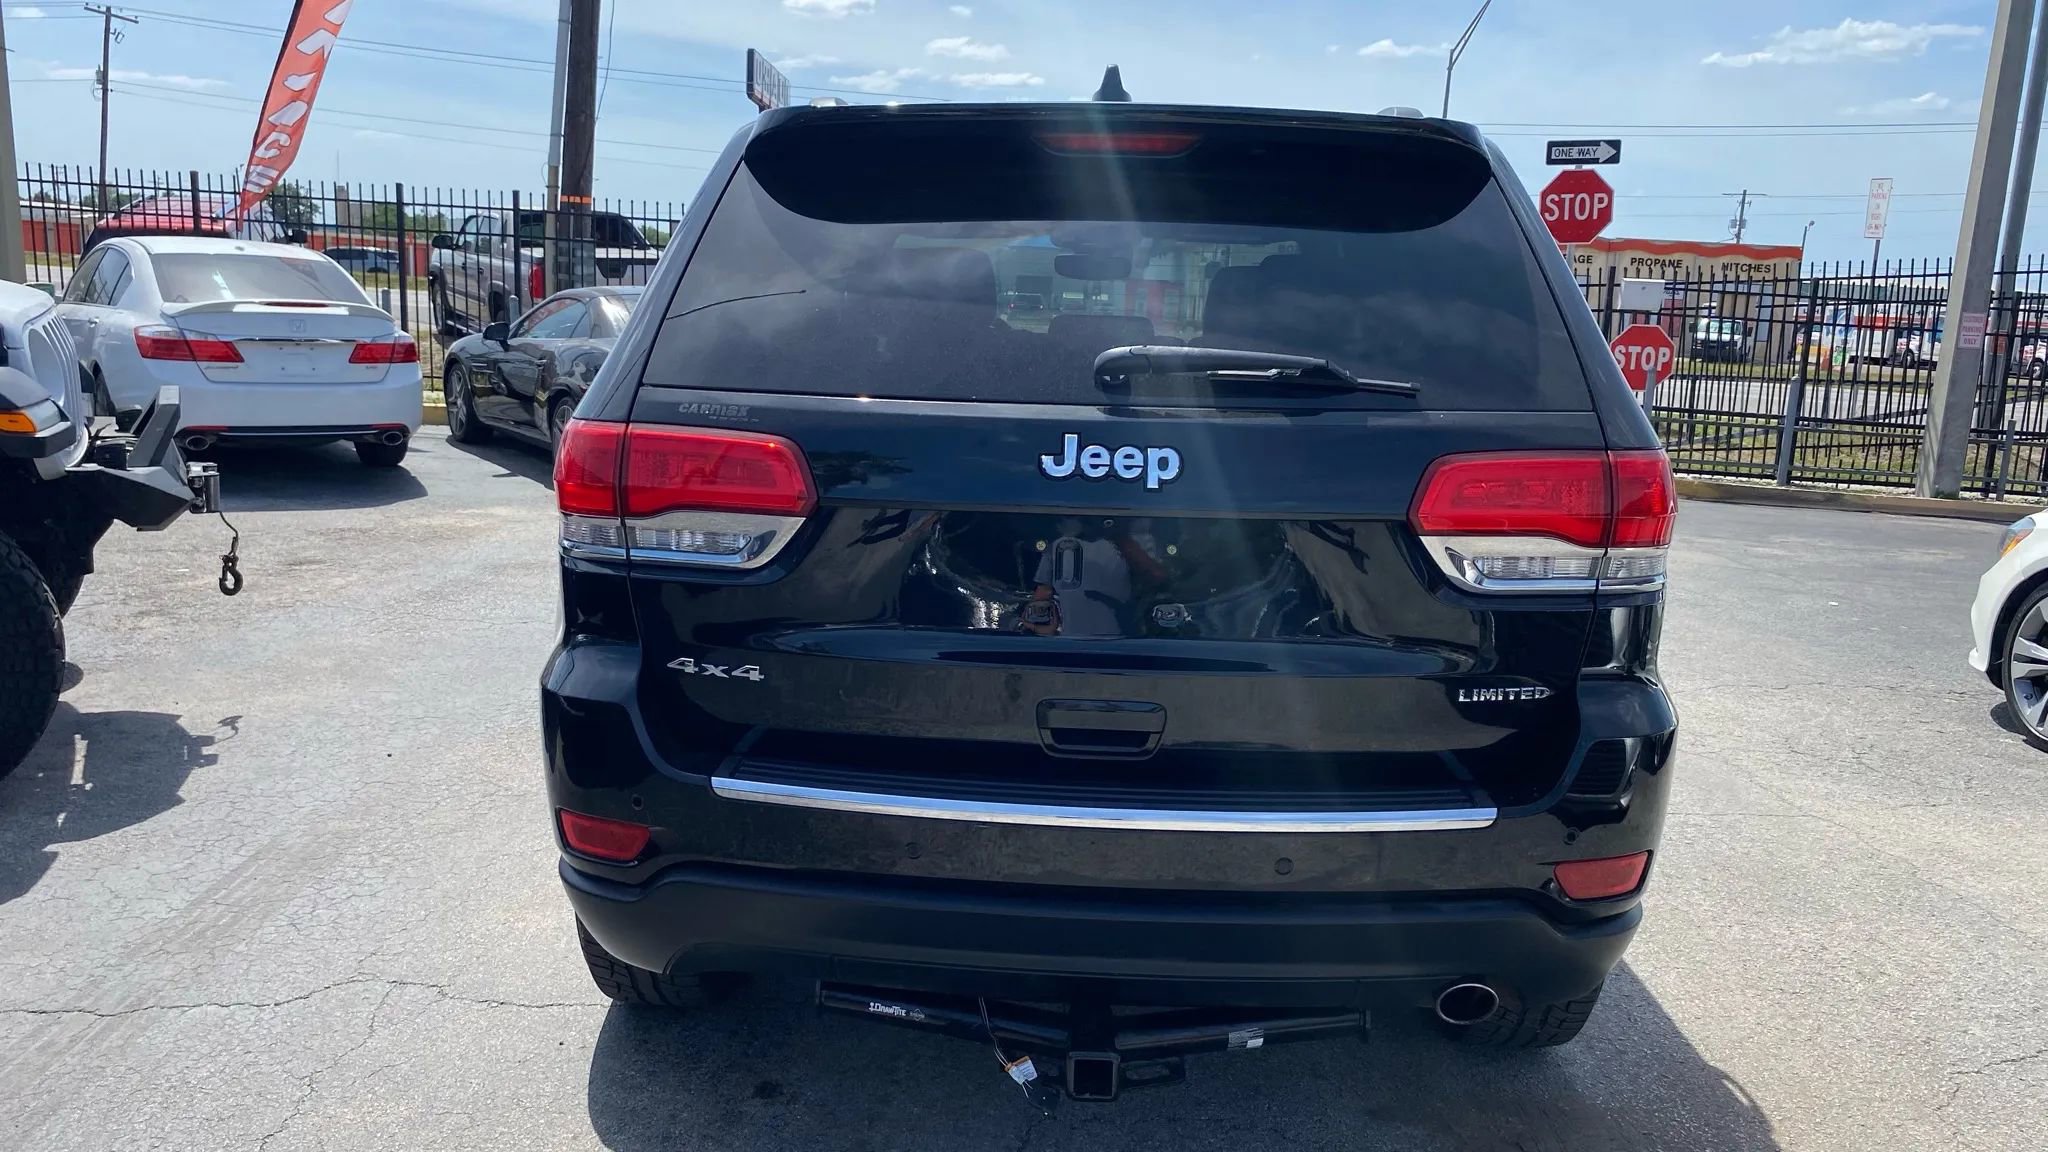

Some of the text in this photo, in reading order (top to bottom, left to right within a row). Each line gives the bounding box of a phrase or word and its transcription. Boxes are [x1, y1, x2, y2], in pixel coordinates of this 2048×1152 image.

[1554, 147, 1598, 158] ONE WAY
[1544, 193, 1609, 221] STOP
[1630, 257, 1683, 268] PROPANE
[1721, 262, 1771, 273] HITCHES
[1613, 345, 1671, 371] STOP
[1041, 434, 1180, 488] Jeep
[667, 658, 765, 681] 4x4
[1459, 687, 1550, 702] LIMITED
